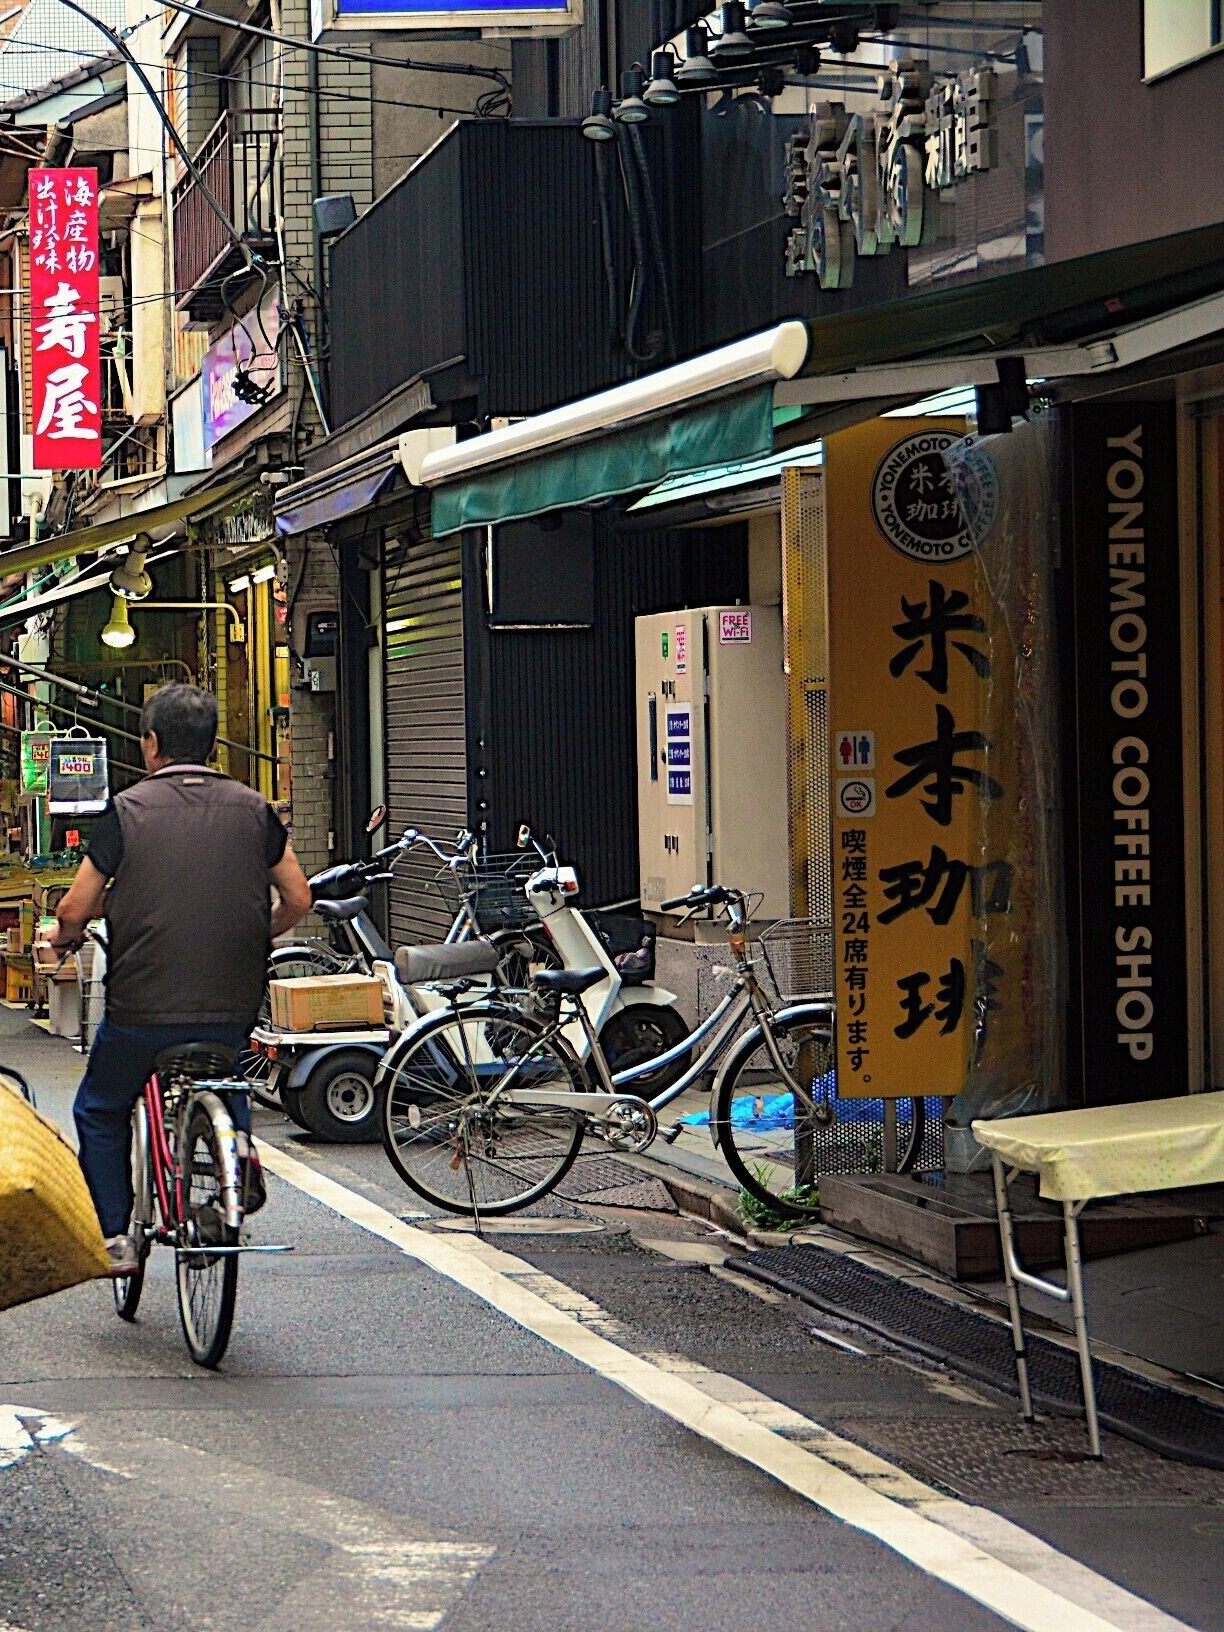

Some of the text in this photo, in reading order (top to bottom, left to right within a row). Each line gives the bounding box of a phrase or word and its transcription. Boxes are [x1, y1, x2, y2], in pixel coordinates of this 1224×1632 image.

[32, 175, 62, 275] 出汁珍味
[64, 177, 96, 274] 海産物
[35, 282, 99, 439] 寿屋
[880, 438, 952, 493] YONEMOTO
[880, 503, 954, 556] YONEMOTO
[722, 615, 748, 625] FREE
[723, 627, 749, 636] Wi-Fi
[1106, 425, 1154, 1061] YONEMOTO COFFEE SHOP
[841, 828, 871, 1084] 喫煙全24席有ります。
